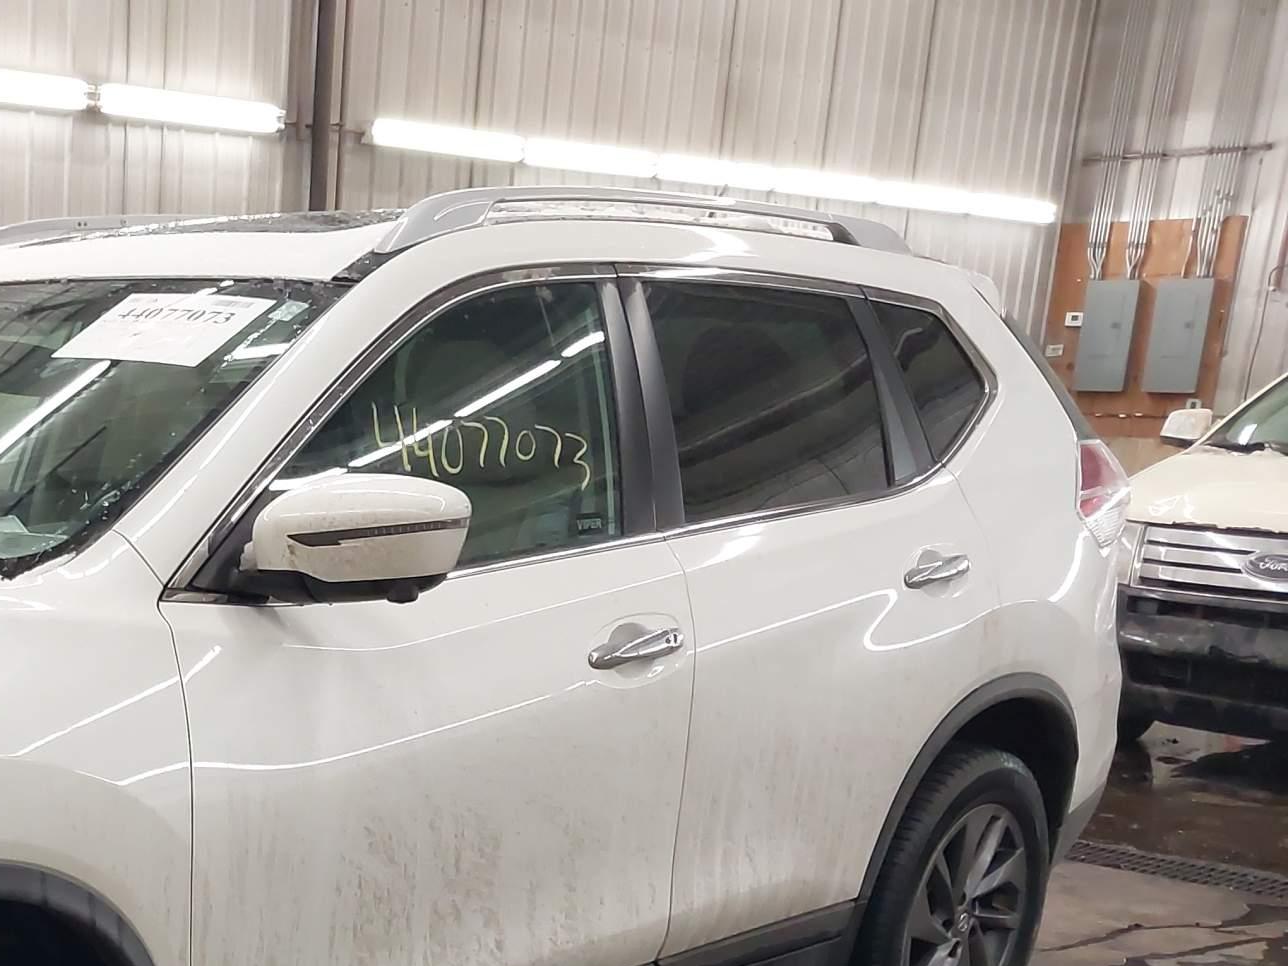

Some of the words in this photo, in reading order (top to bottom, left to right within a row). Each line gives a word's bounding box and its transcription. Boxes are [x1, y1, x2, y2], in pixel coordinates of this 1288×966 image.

[118, 307, 236, 325] 44077073
[372, 401, 591, 491] 44077073
[1259, 557, 1288, 571] For
